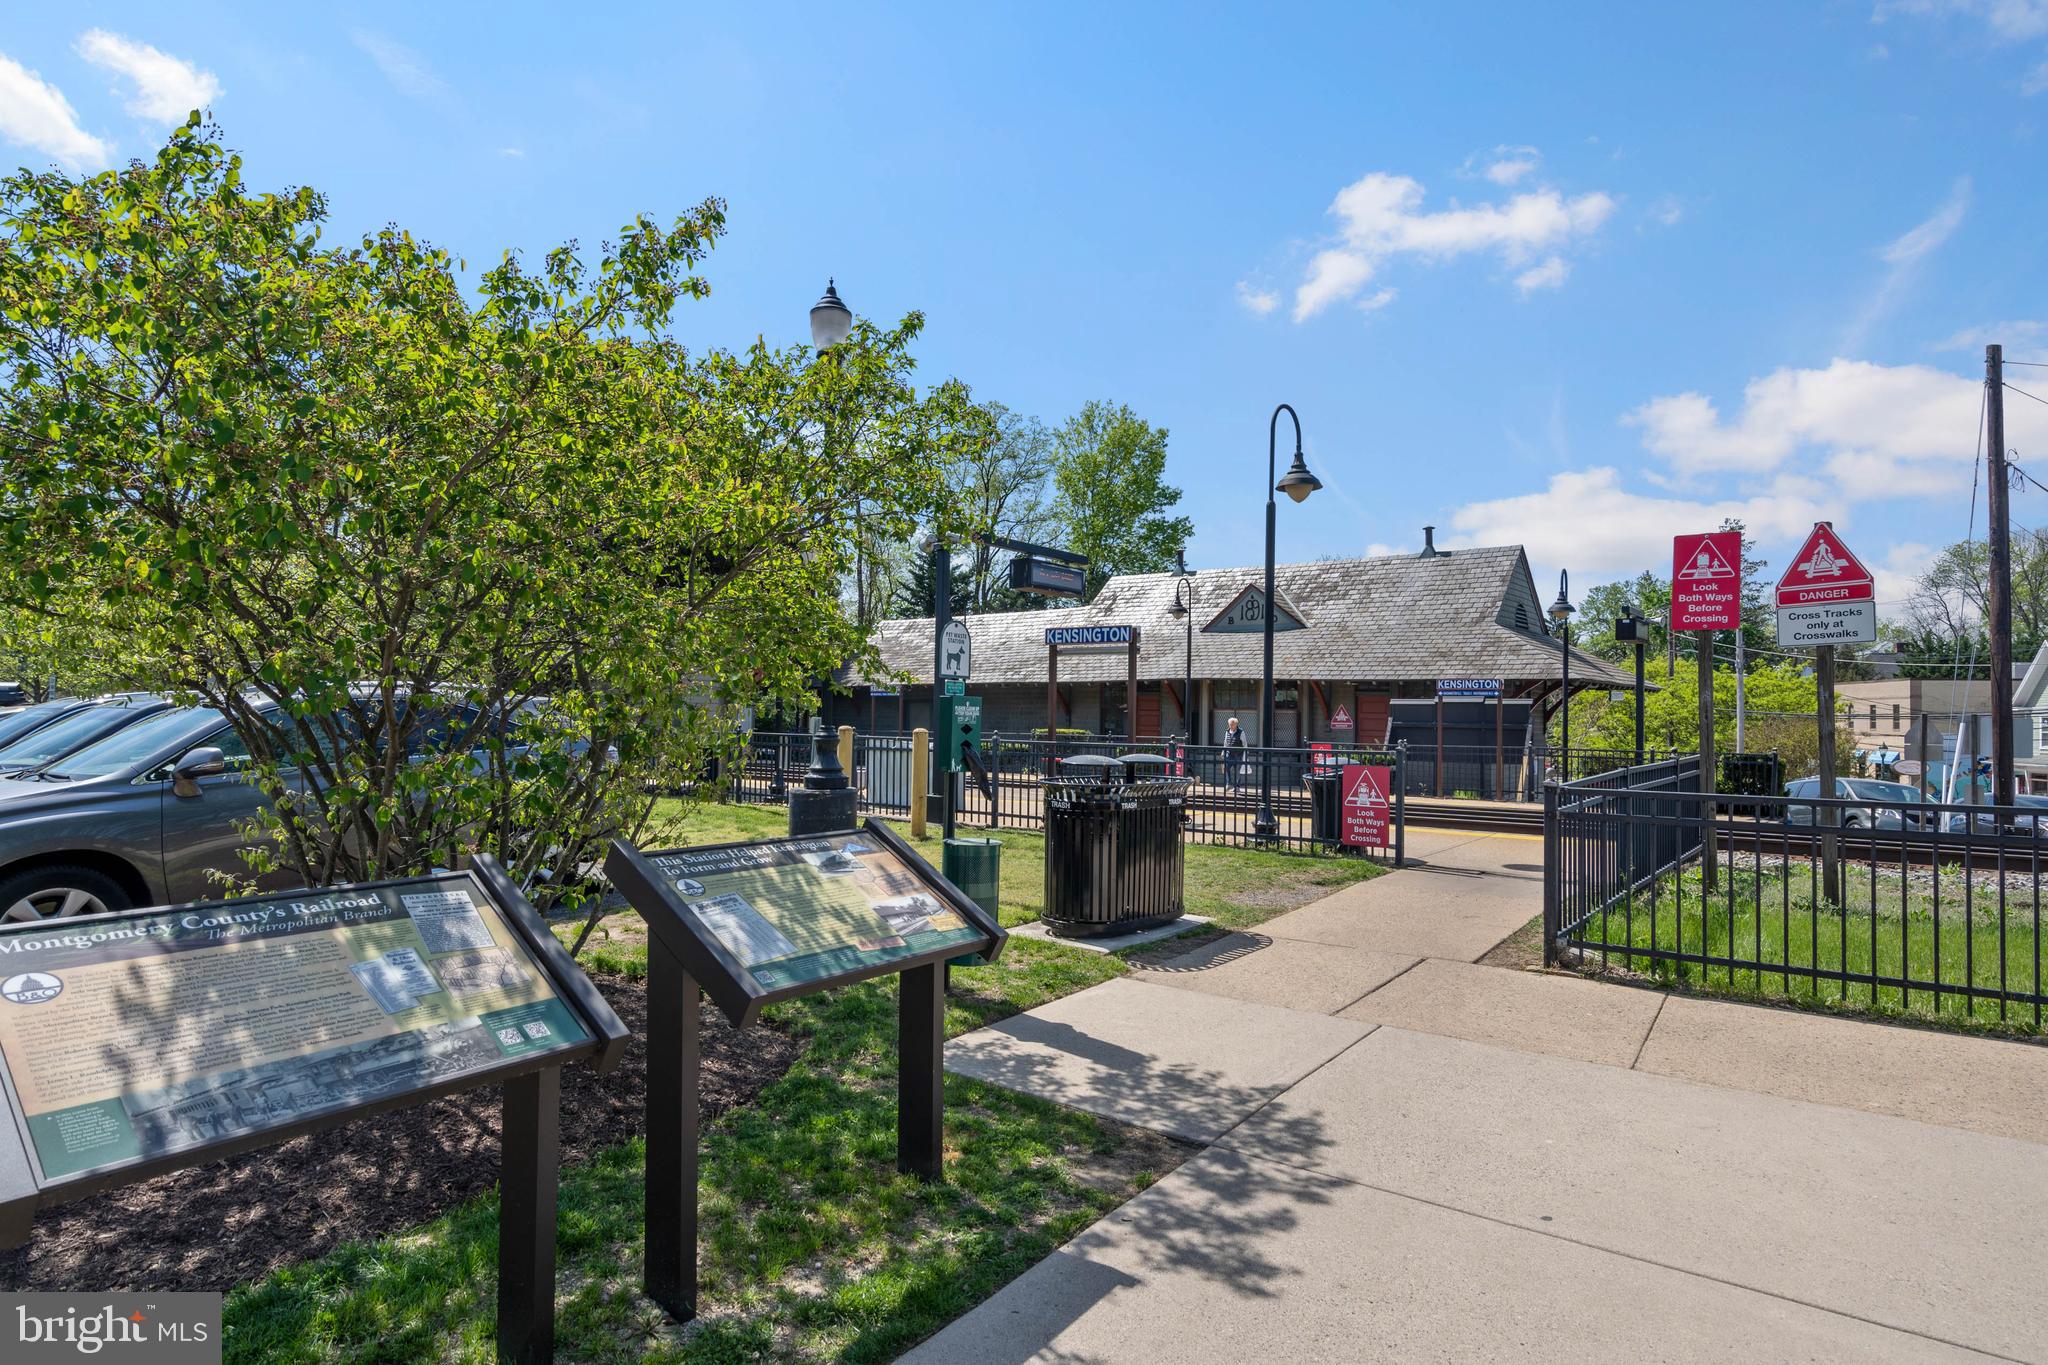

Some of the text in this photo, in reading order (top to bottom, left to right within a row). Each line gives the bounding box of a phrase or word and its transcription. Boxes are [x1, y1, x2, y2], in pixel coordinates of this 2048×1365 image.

[1692, 582, 1718, 592] Look
[1679, 593, 1733, 603] Both Ways
[1799, 588, 1849, 601] DANGER
[1688, 604, 1723, 612] Before
[1682, 614, 1729, 624] Crossing
[1788, 608, 1863, 621] Cross Tracks
[1806, 619, 1844, 631] only at
[1046, 626, 1131, 643] KENSINGTON
[1793, 628, 1859, 641] Crosswalks
[1438, 680, 1499, 689] KENSINGTON
[1051, 800, 1071, 809] TRASH
[1121, 801, 1137, 810] TRASH
[1168, 798, 1182, 806] TRASH
[1357, 809, 1375, 817] Look
[1366, 818, 1385, 827] Ways
[1354, 826, 1378, 834] Before
[1350, 834, 1381, 844] Crossing
[652, 840, 830, 868] This Station Helped Kensington
[660, 856, 773, 876] To Form and Grow
[0, 923, 173, 954] Montgomery
[290, 893, 382, 916] Railroad
[207, 927, 233, 940] The
[240, 915, 338, 935] Metropolitan
[344, 907, 392, 921] Branch
